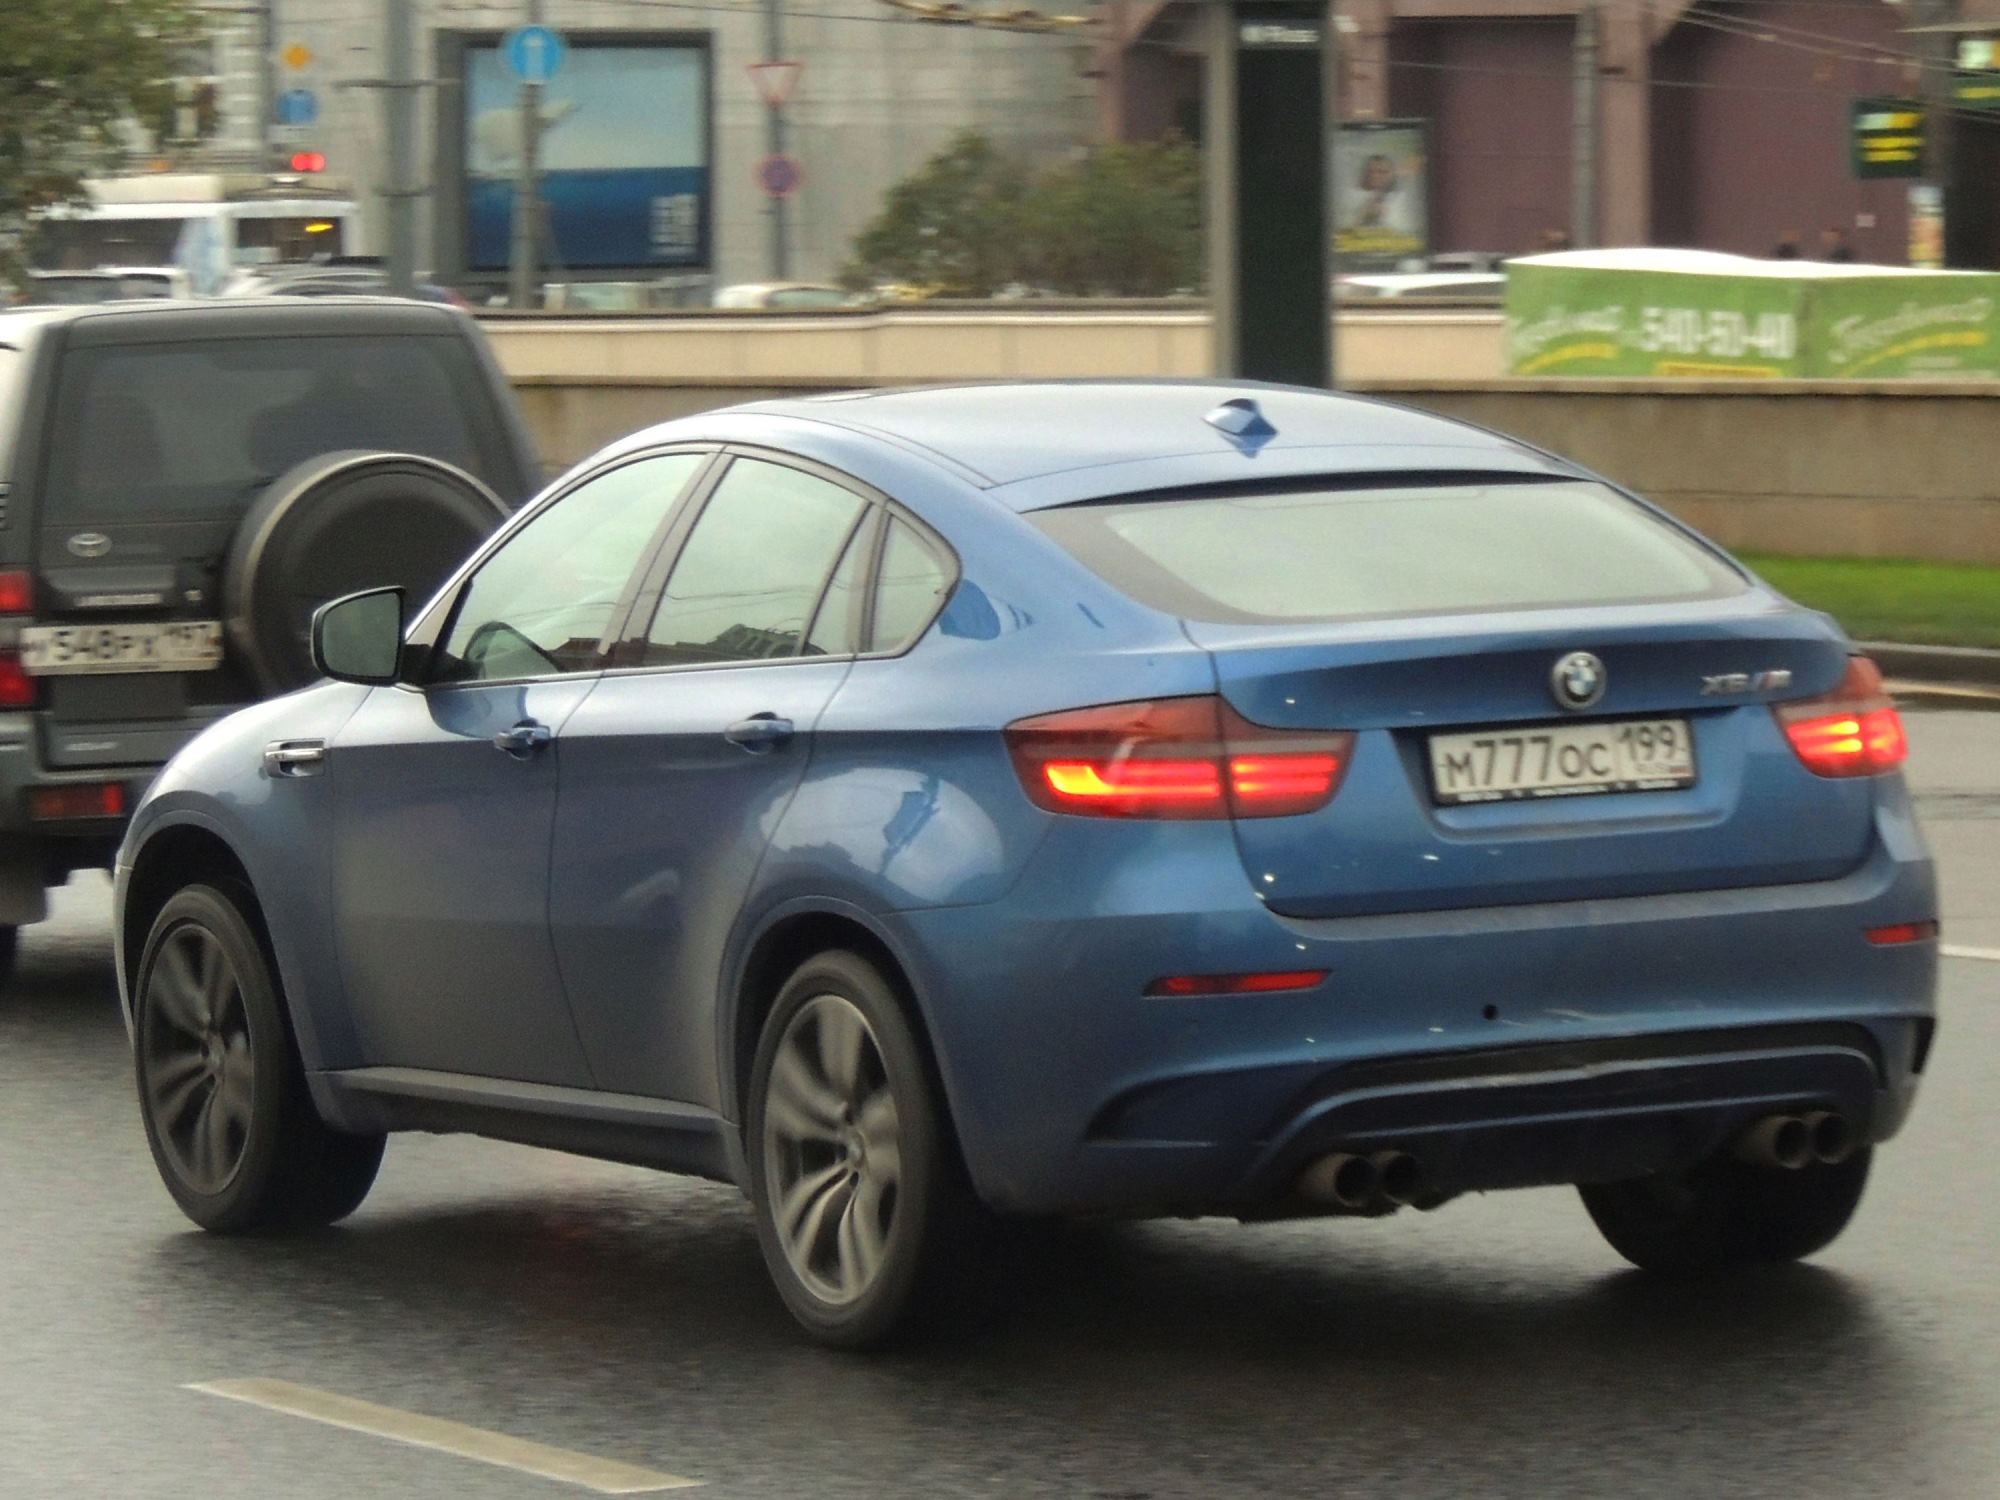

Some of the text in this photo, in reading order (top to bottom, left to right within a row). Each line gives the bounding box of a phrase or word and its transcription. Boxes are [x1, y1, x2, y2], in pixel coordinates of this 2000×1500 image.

[1640, 306, 1795, 359] 540-50-40
[1443, 724, 1676, 788] М777ОС 199
